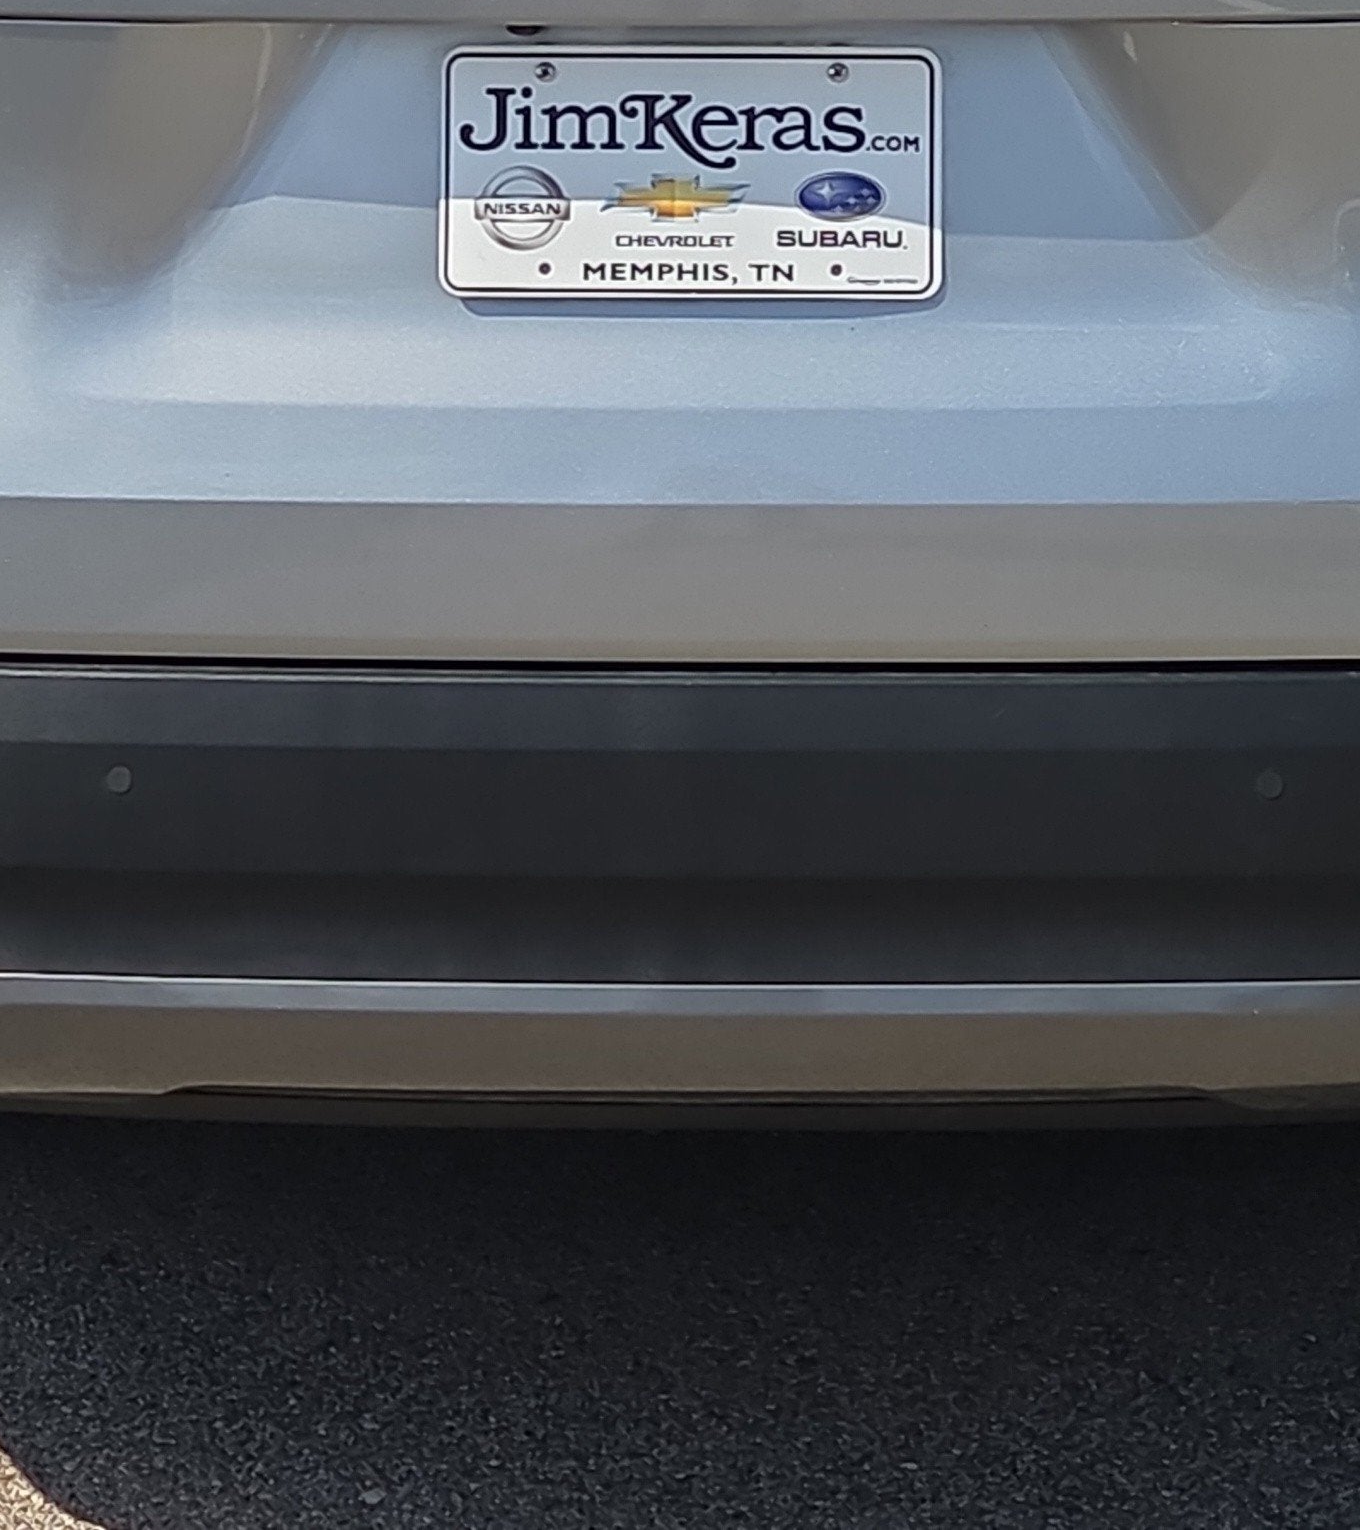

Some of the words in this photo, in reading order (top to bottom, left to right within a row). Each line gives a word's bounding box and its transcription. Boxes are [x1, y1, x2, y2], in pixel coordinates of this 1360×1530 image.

[482, 202, 561, 217] NISSAN
[614, 234, 735, 248] CHEVROLET
[776, 230, 904, 249] SUBARU
[582, 262, 738, 285] MEMPHIS,
[748, 264, 795, 281] TN
